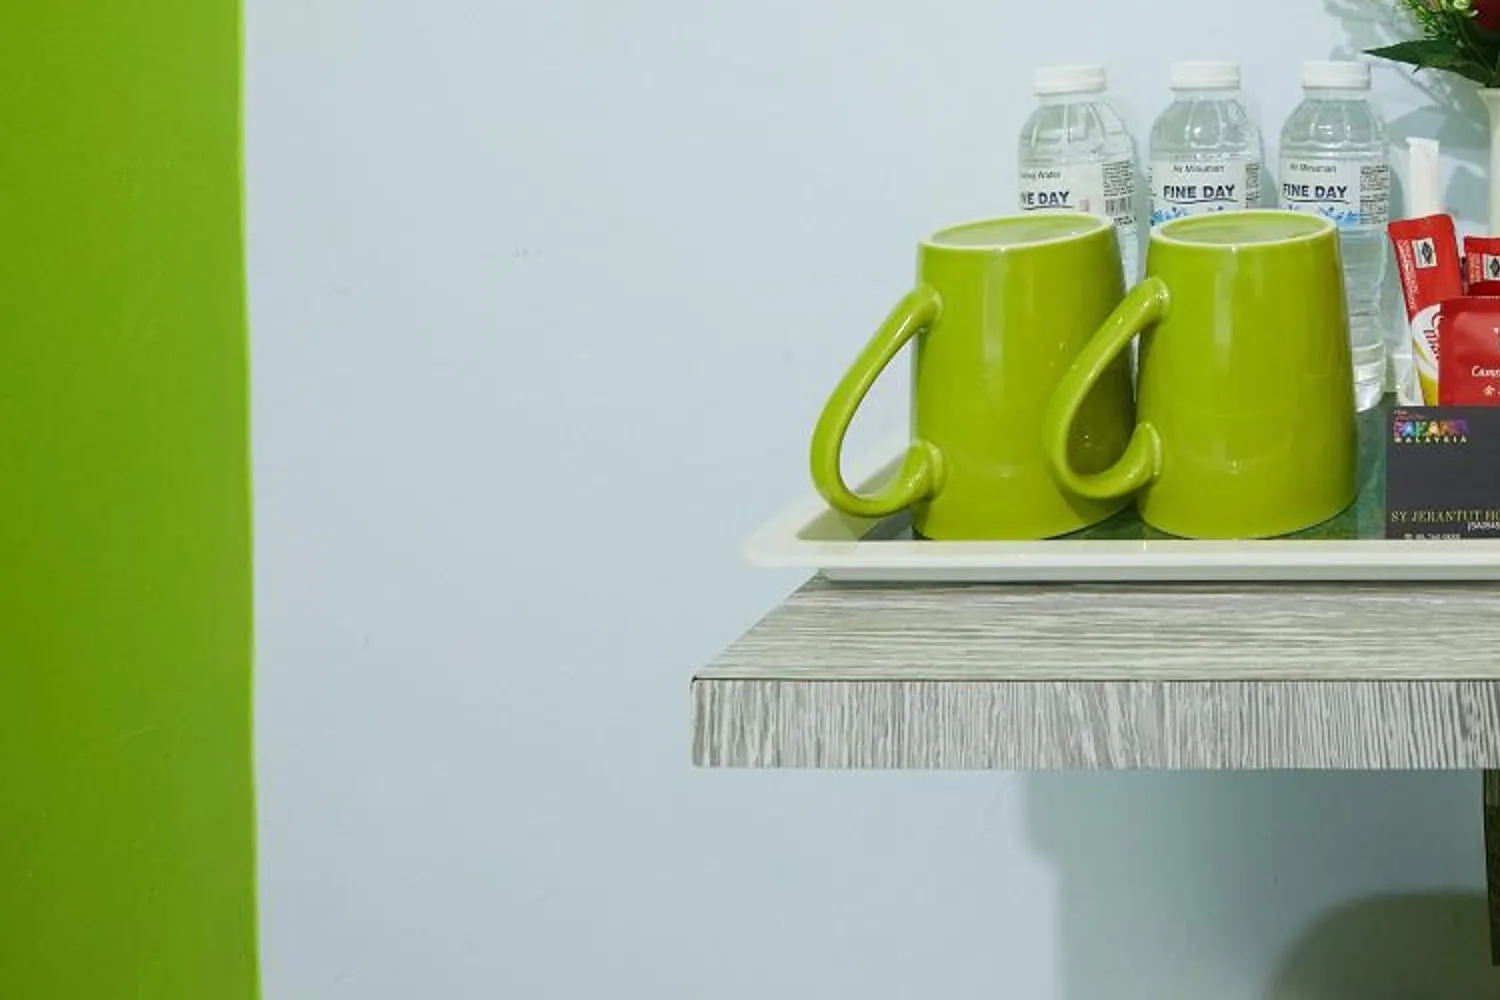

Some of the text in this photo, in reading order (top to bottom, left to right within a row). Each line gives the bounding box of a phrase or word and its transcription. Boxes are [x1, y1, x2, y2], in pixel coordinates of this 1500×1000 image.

[1038, 191, 1070, 205] DAY
[1163, 184, 1236, 199] FINE DAY
[1283, 183, 1348, 199] FINE DAY
[1391, 511, 1407, 522] SY
[1411, 510, 1480, 522] JERANTUT
